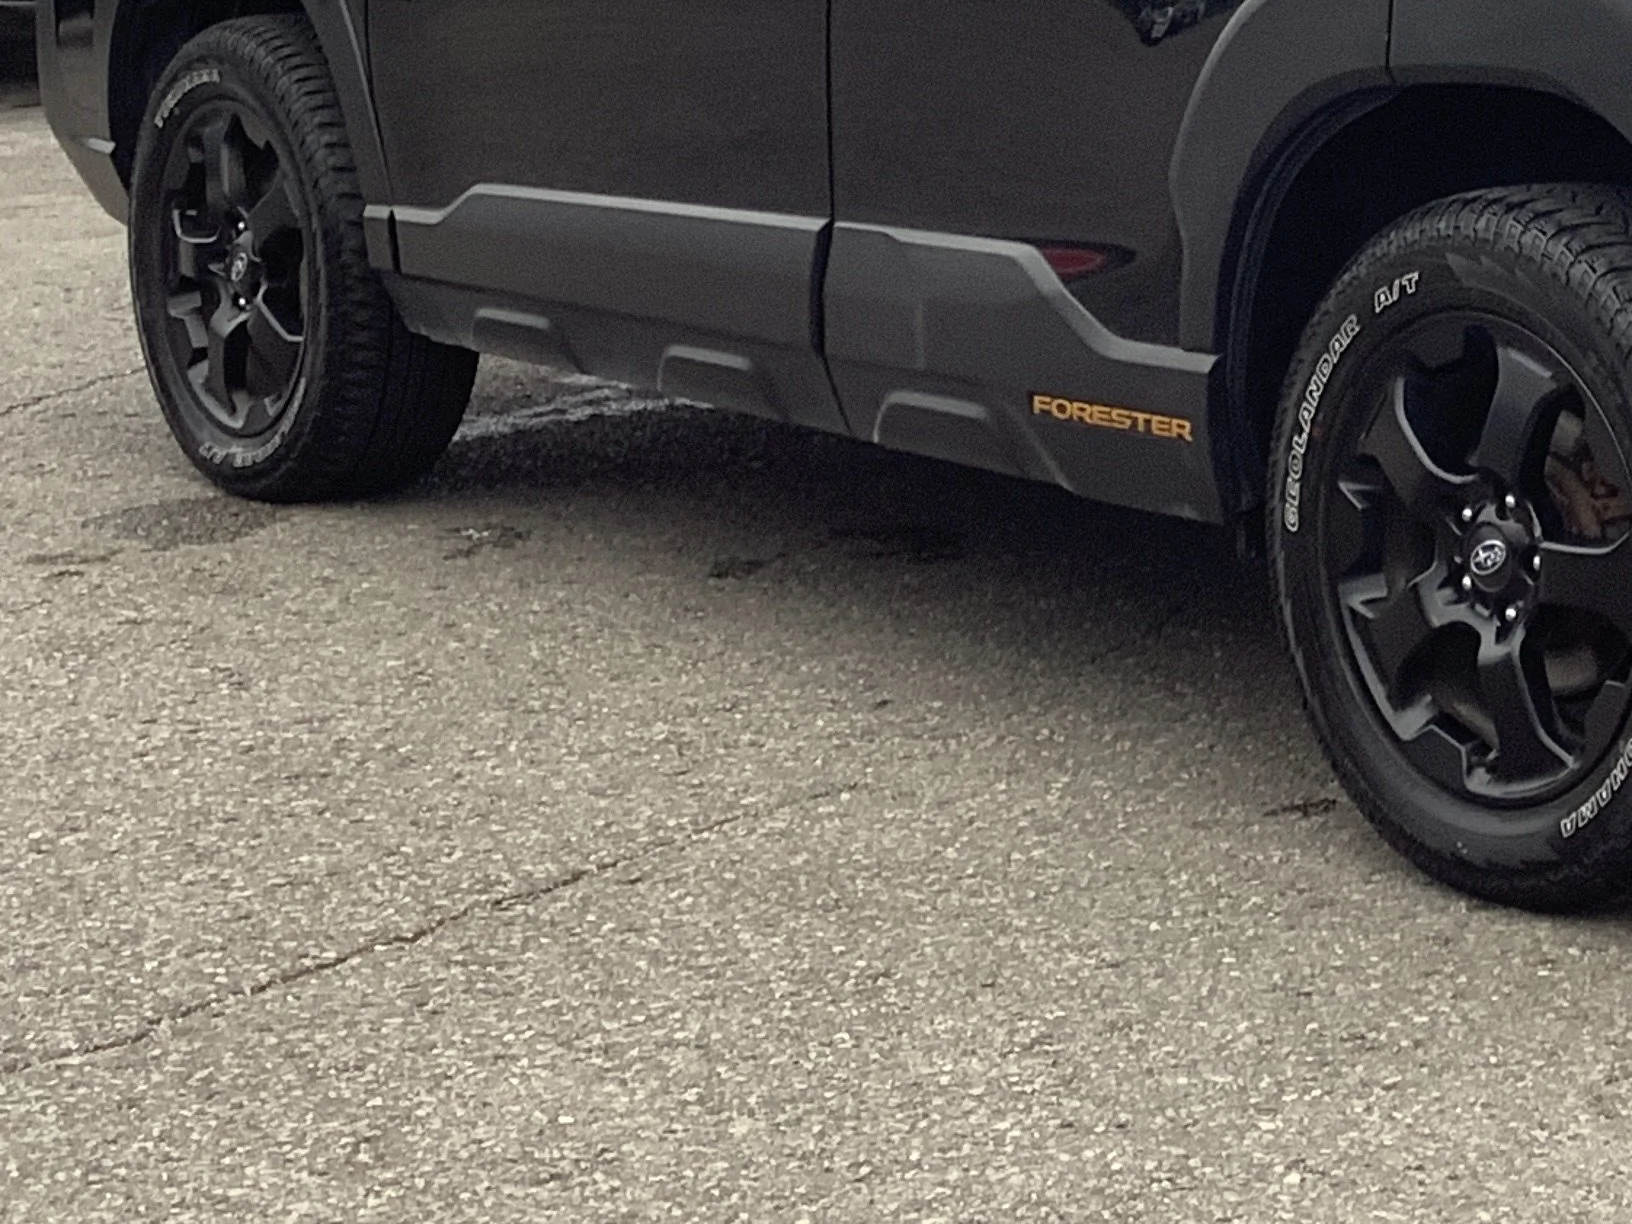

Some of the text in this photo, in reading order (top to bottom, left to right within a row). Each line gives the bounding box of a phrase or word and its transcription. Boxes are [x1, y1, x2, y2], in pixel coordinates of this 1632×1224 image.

[1032, 394, 1193, 443] FORESTER
[1283, 270, 1420, 533] GEOLANDAR A/T
